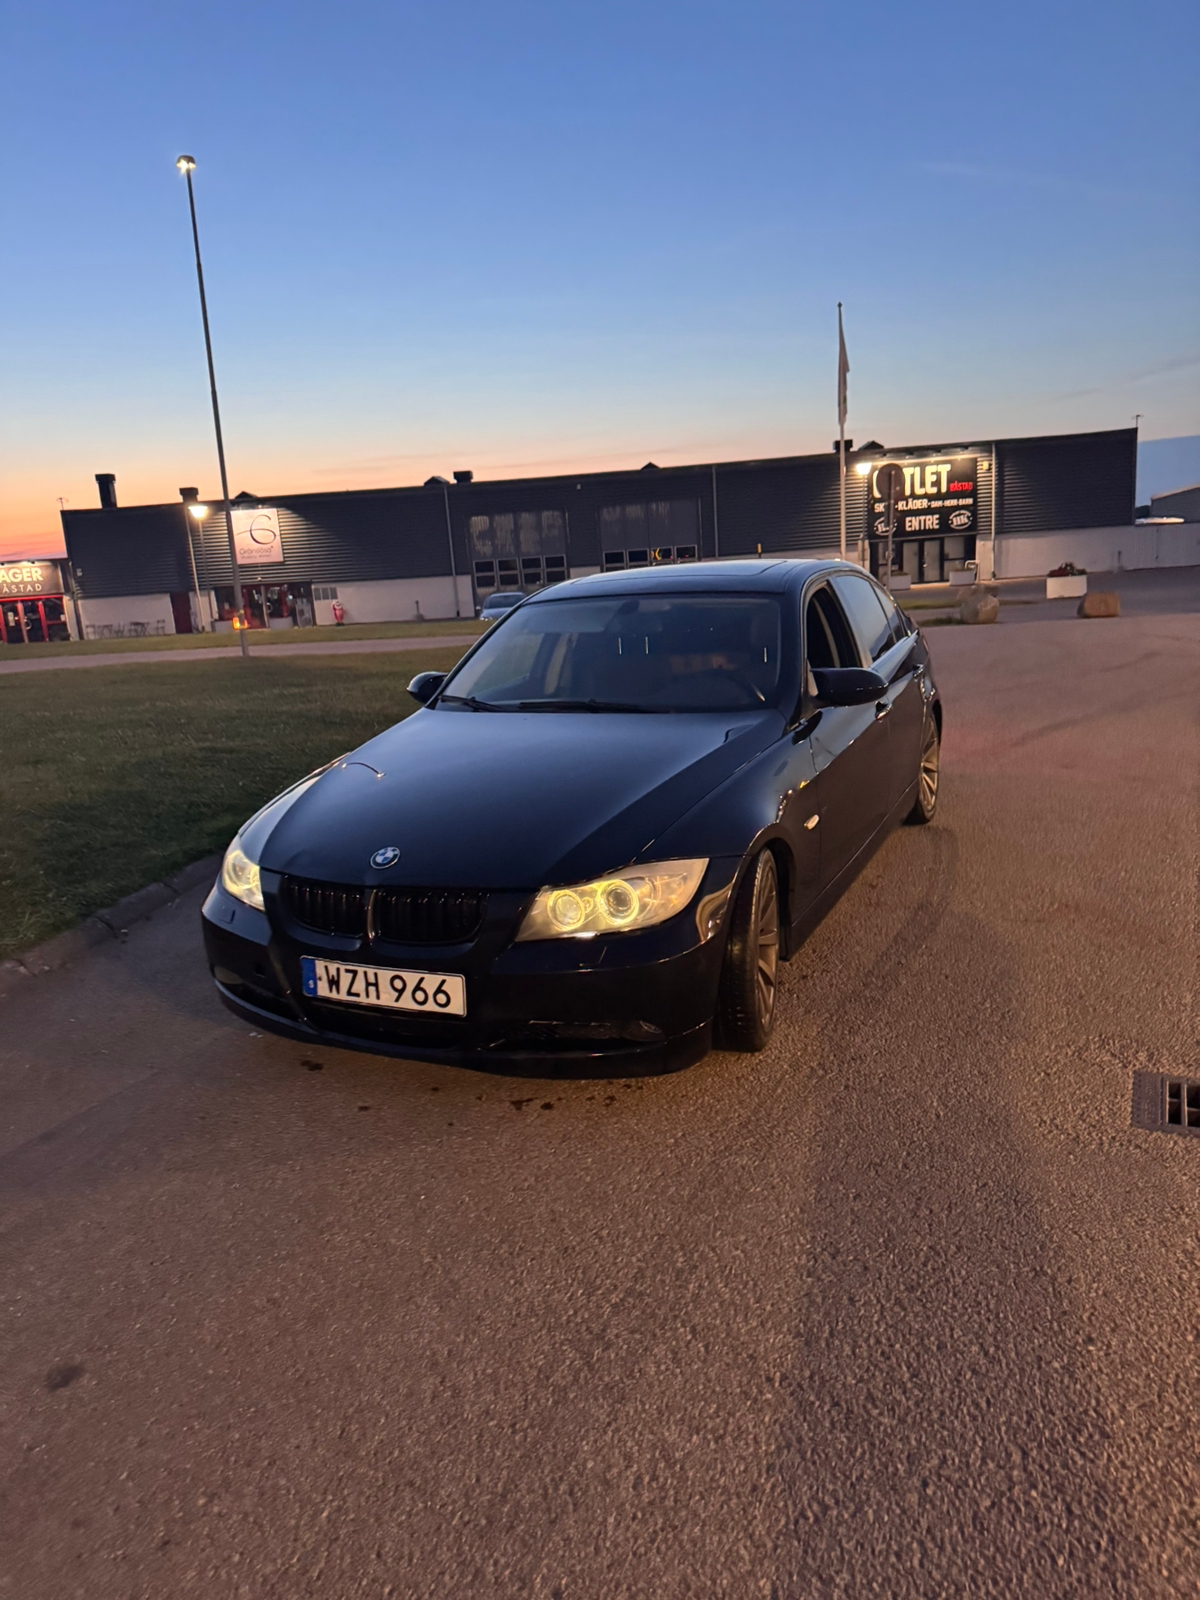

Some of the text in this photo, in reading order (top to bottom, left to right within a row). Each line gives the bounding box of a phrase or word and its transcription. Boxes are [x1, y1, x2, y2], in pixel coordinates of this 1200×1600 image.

[873, 464, 951, 498] TLET
[898, 498, 928, 511] KLÄDER
[905, 514, 939, 531] ENTRE
[0, 567, 43, 583] AGER
[2, 583, 42, 593] ÅSTAD
[324, 965, 451, 1008] WZH 966
